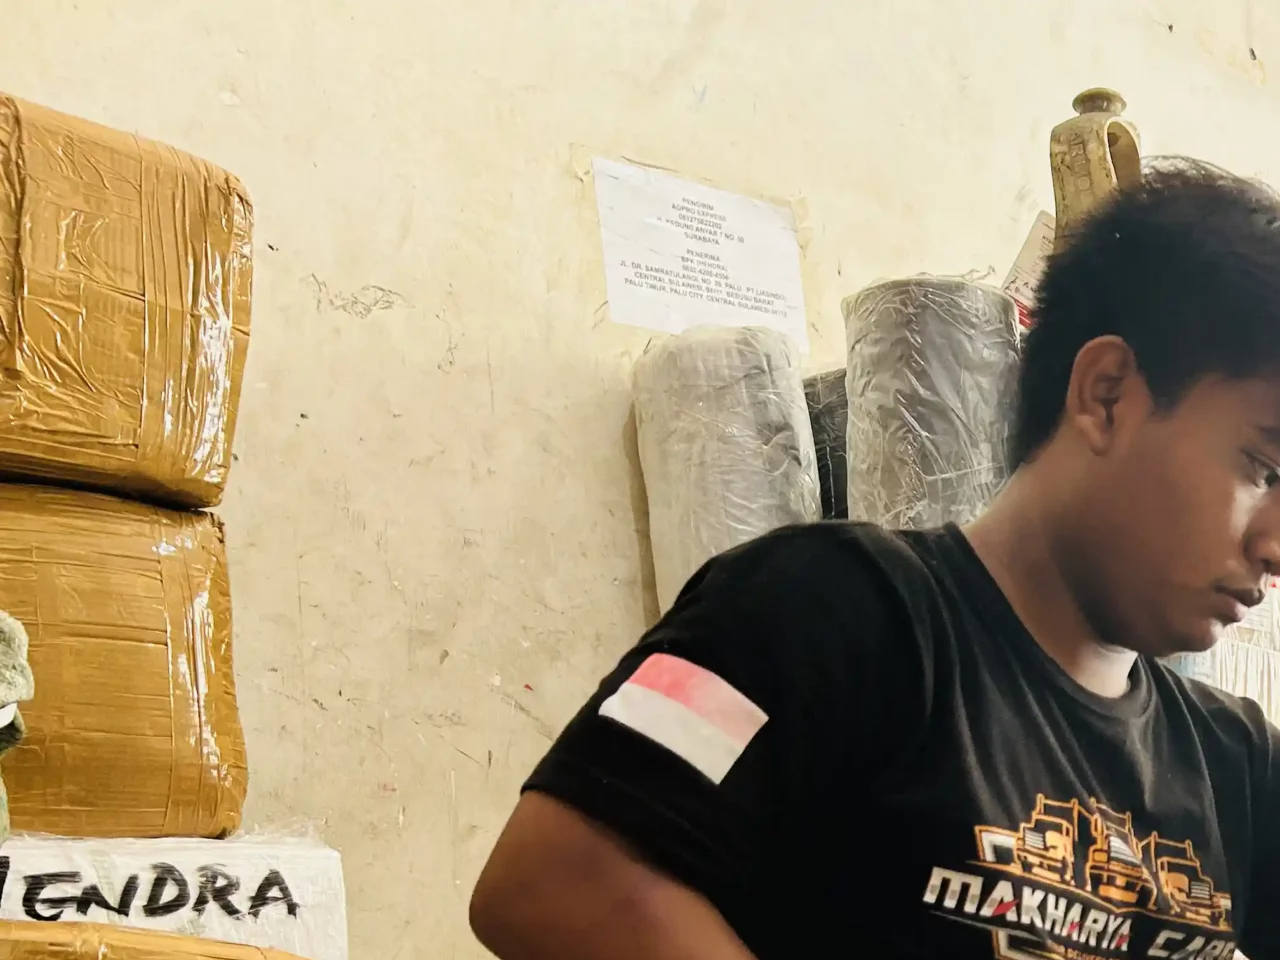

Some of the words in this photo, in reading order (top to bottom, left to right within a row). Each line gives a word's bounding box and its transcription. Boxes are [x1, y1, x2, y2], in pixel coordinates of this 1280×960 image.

[684, 231, 720, 245] SURABAYA
[686, 248, 720, 262] PENERIMA
[624, 277, 643, 287] PALU
[670, 286, 686, 296] PALU
[922, 866, 1132, 951] MAKHARYA
